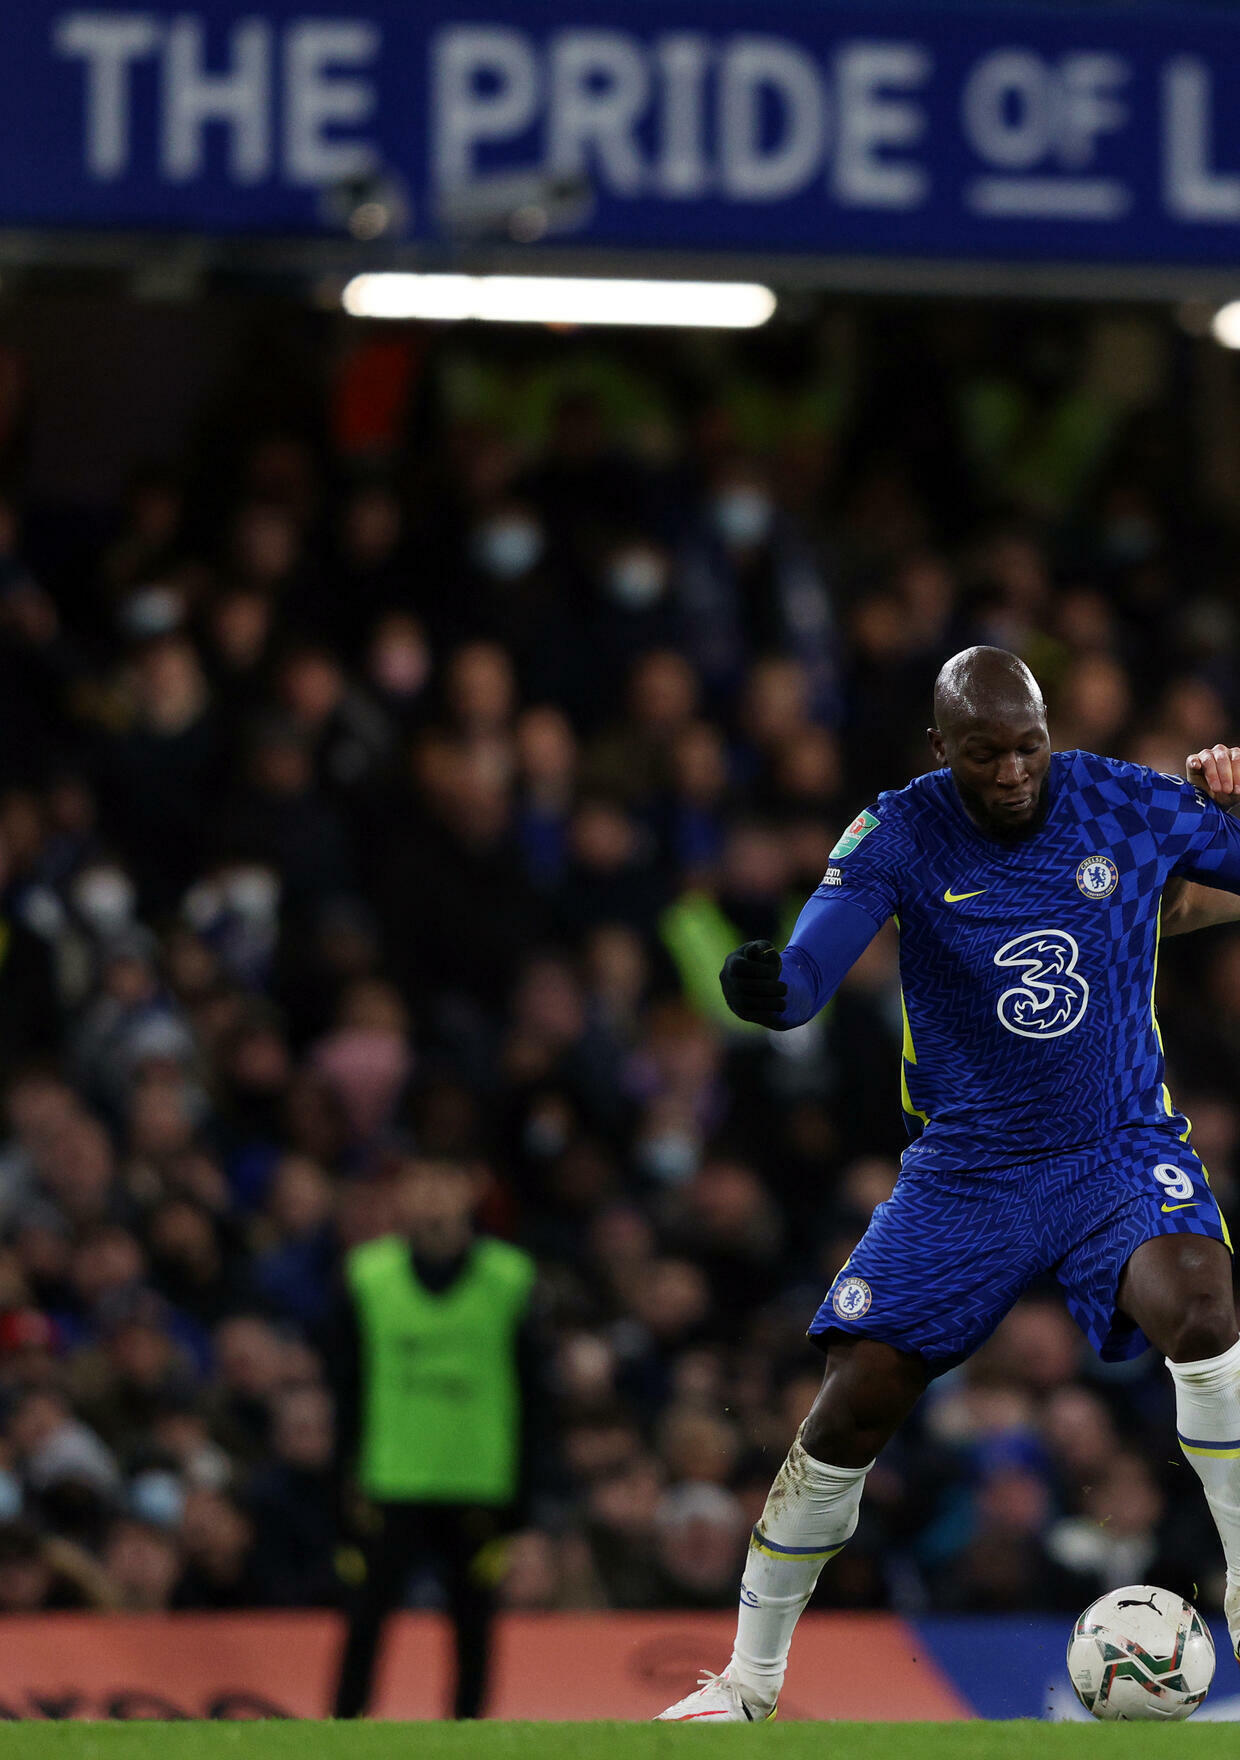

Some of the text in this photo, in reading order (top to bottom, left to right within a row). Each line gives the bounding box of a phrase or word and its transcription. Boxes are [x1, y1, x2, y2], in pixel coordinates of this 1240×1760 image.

[58, 17, 380, 184] THE
[432, 25, 931, 208] PRIDE
[963, 49, 1131, 169] OF
[1081, 857, 1107, 870] CHELSEA
[1153, 1164, 1195, 1200] 9
